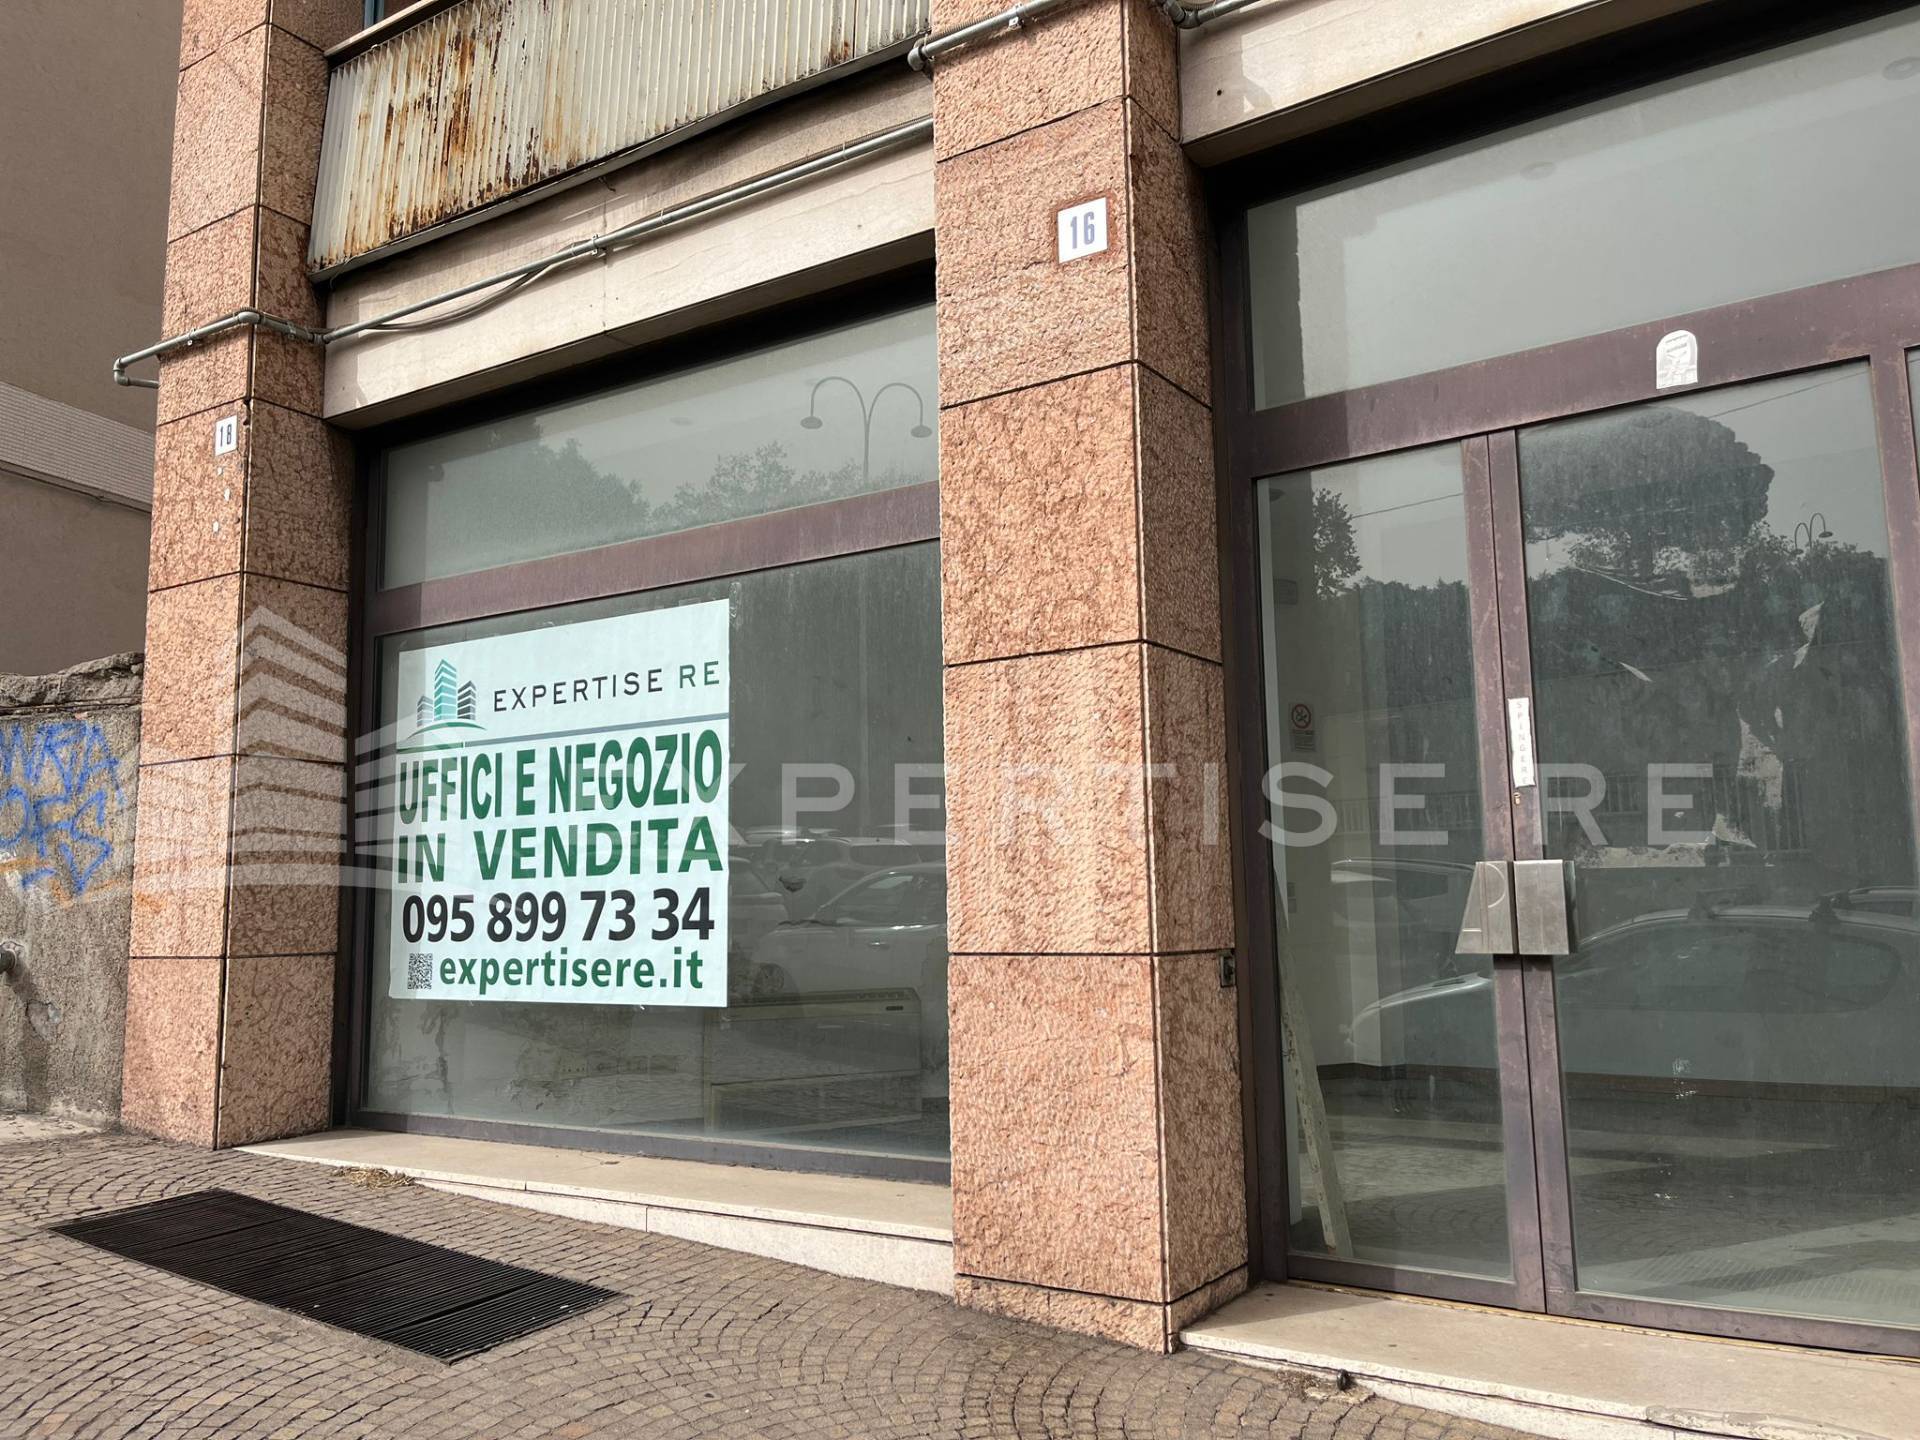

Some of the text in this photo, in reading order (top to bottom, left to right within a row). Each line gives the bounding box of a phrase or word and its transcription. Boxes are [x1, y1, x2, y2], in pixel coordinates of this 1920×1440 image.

[1071, 211, 1095, 249] 16
[220, 424, 232, 447] 18
[493, 661, 720, 713] EXPERTISE RE
[1515, 700, 1530, 785] SPINGERE
[399, 729, 723, 825] UFFICI E NEGOZIO
[398, 815, 724, 884] IN VENDITA
[402, 887, 715, 943] 095 899 73 34
[439, 946, 704, 995] expertisere.it
